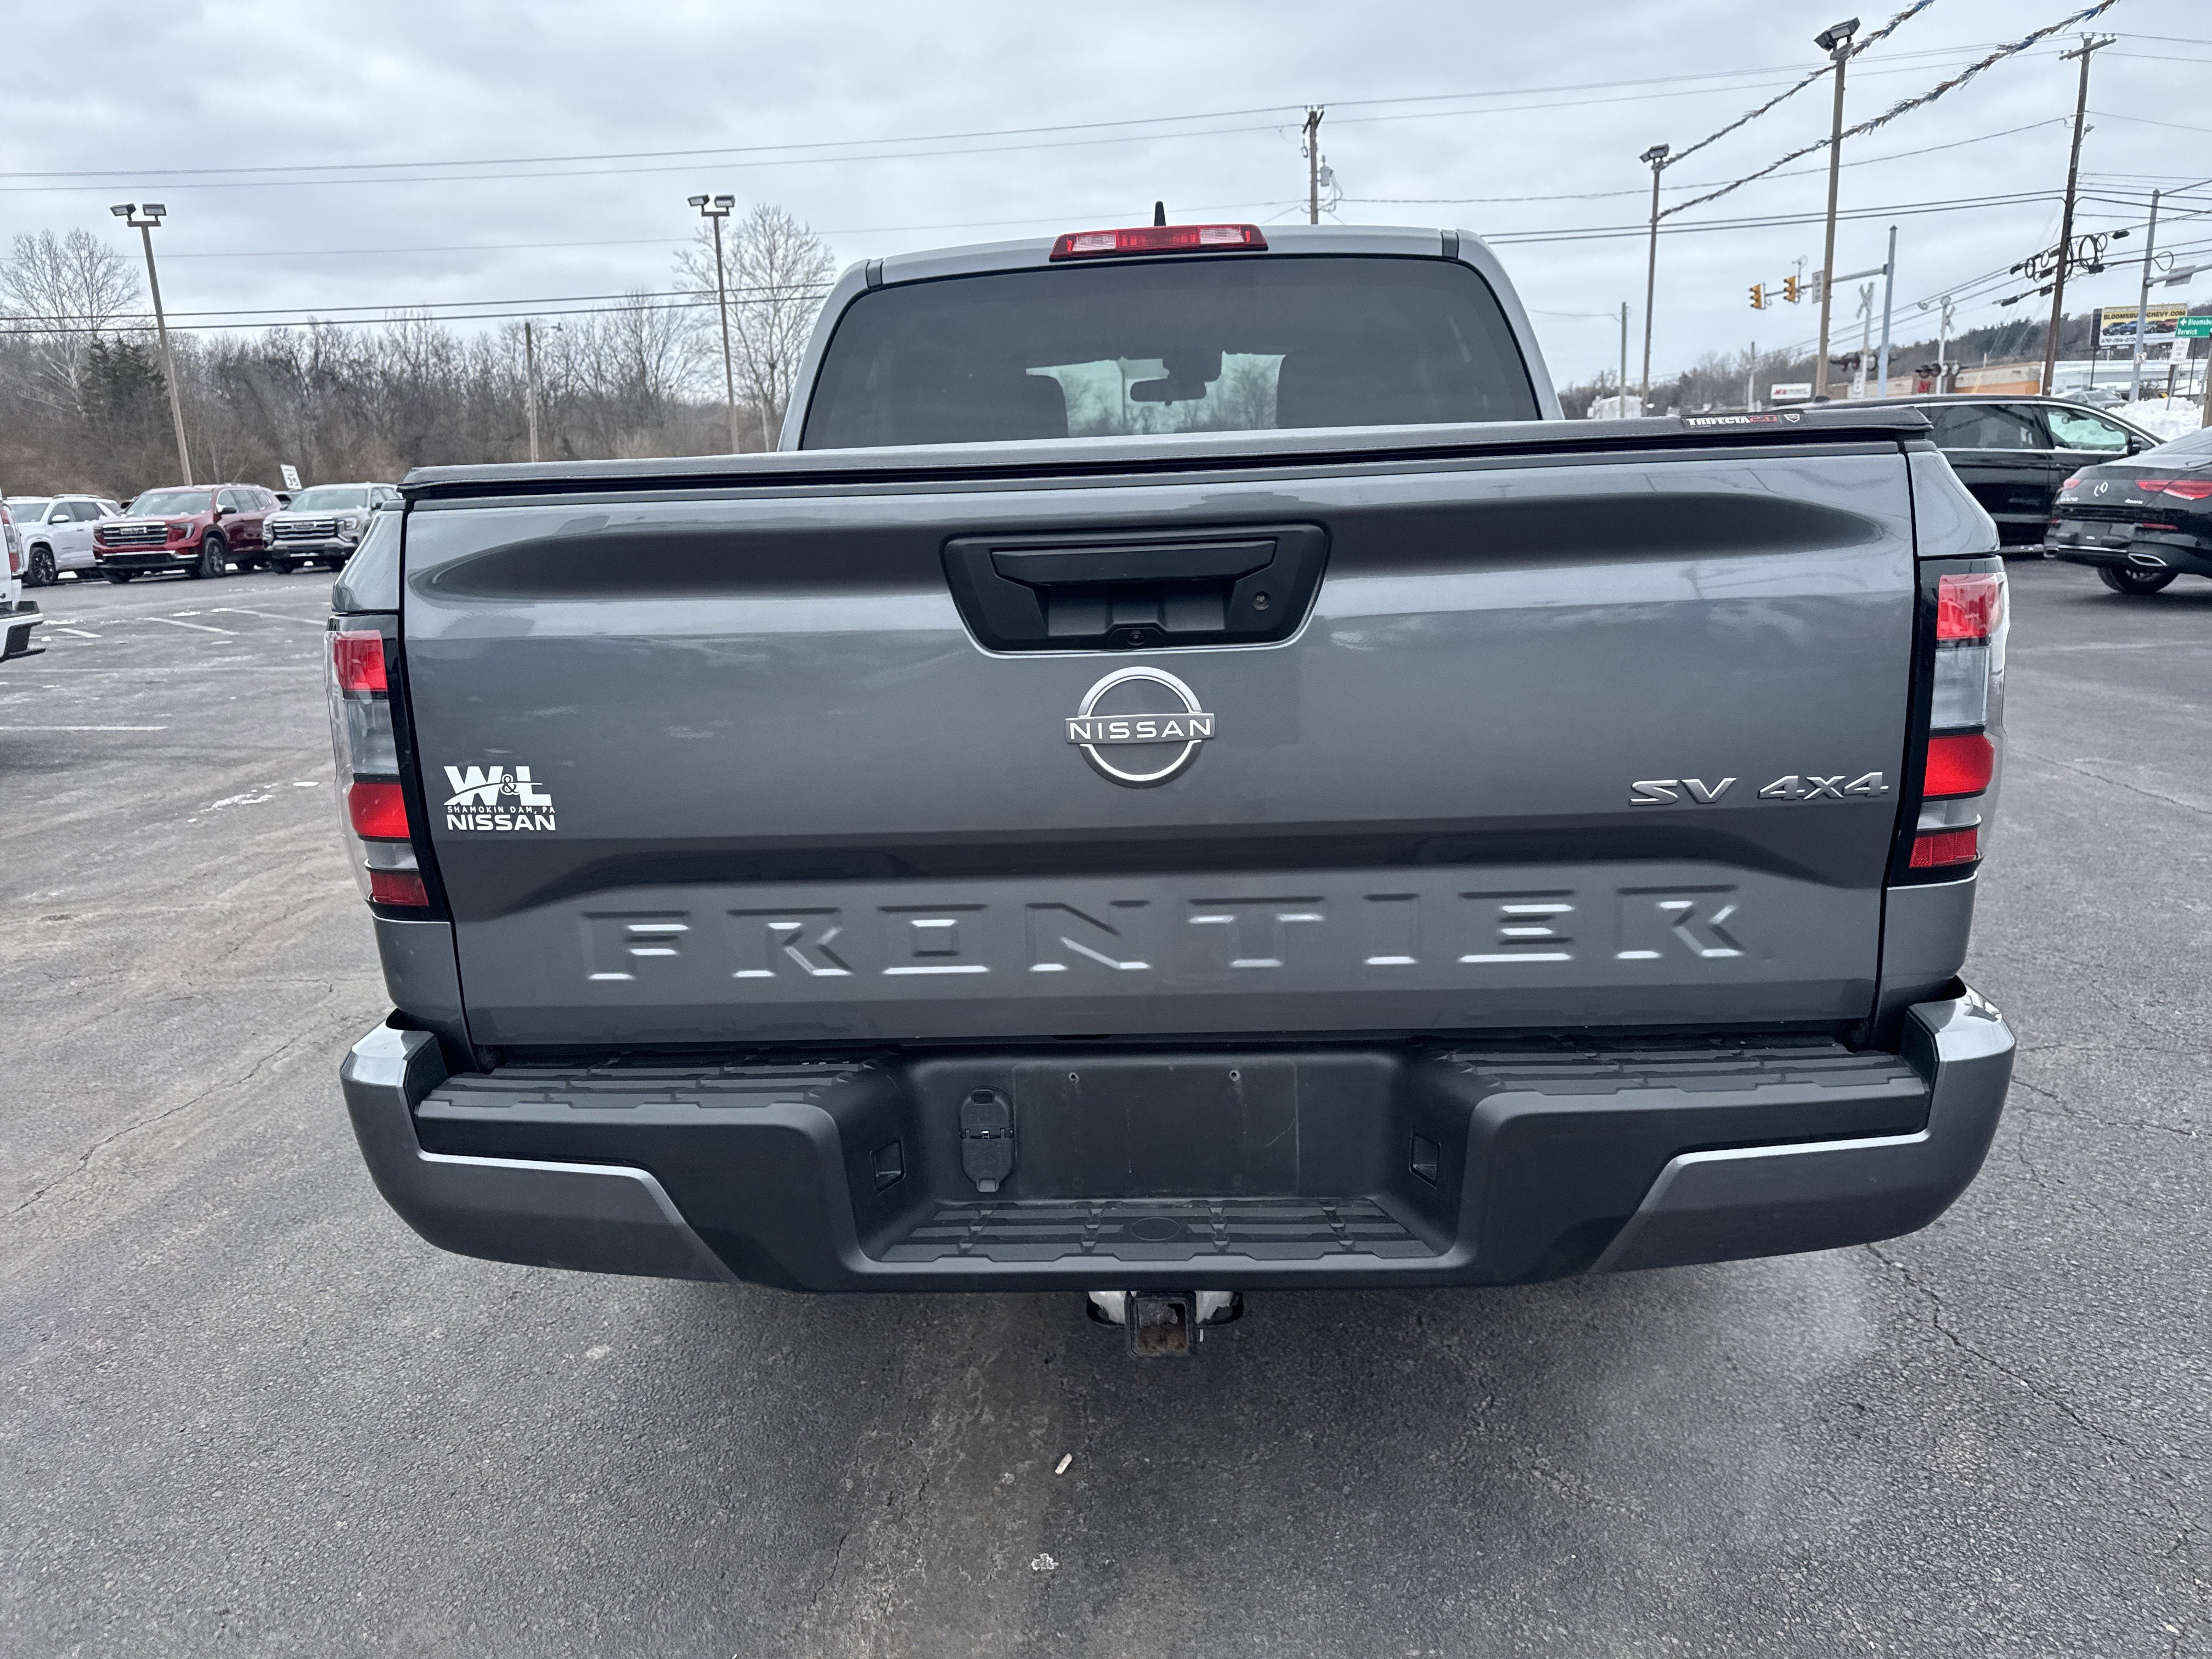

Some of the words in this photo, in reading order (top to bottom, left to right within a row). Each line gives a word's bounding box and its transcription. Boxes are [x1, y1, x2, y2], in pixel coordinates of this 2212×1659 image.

[1070, 719, 1211, 740] NISSAN
[443, 766, 552, 806] W&L
[1629, 777, 1737, 806] SV
[447, 815, 556, 831] NISSAN
[510, 806, 538, 815] DAM,
[579, 885, 1744, 980] FRONTIER
